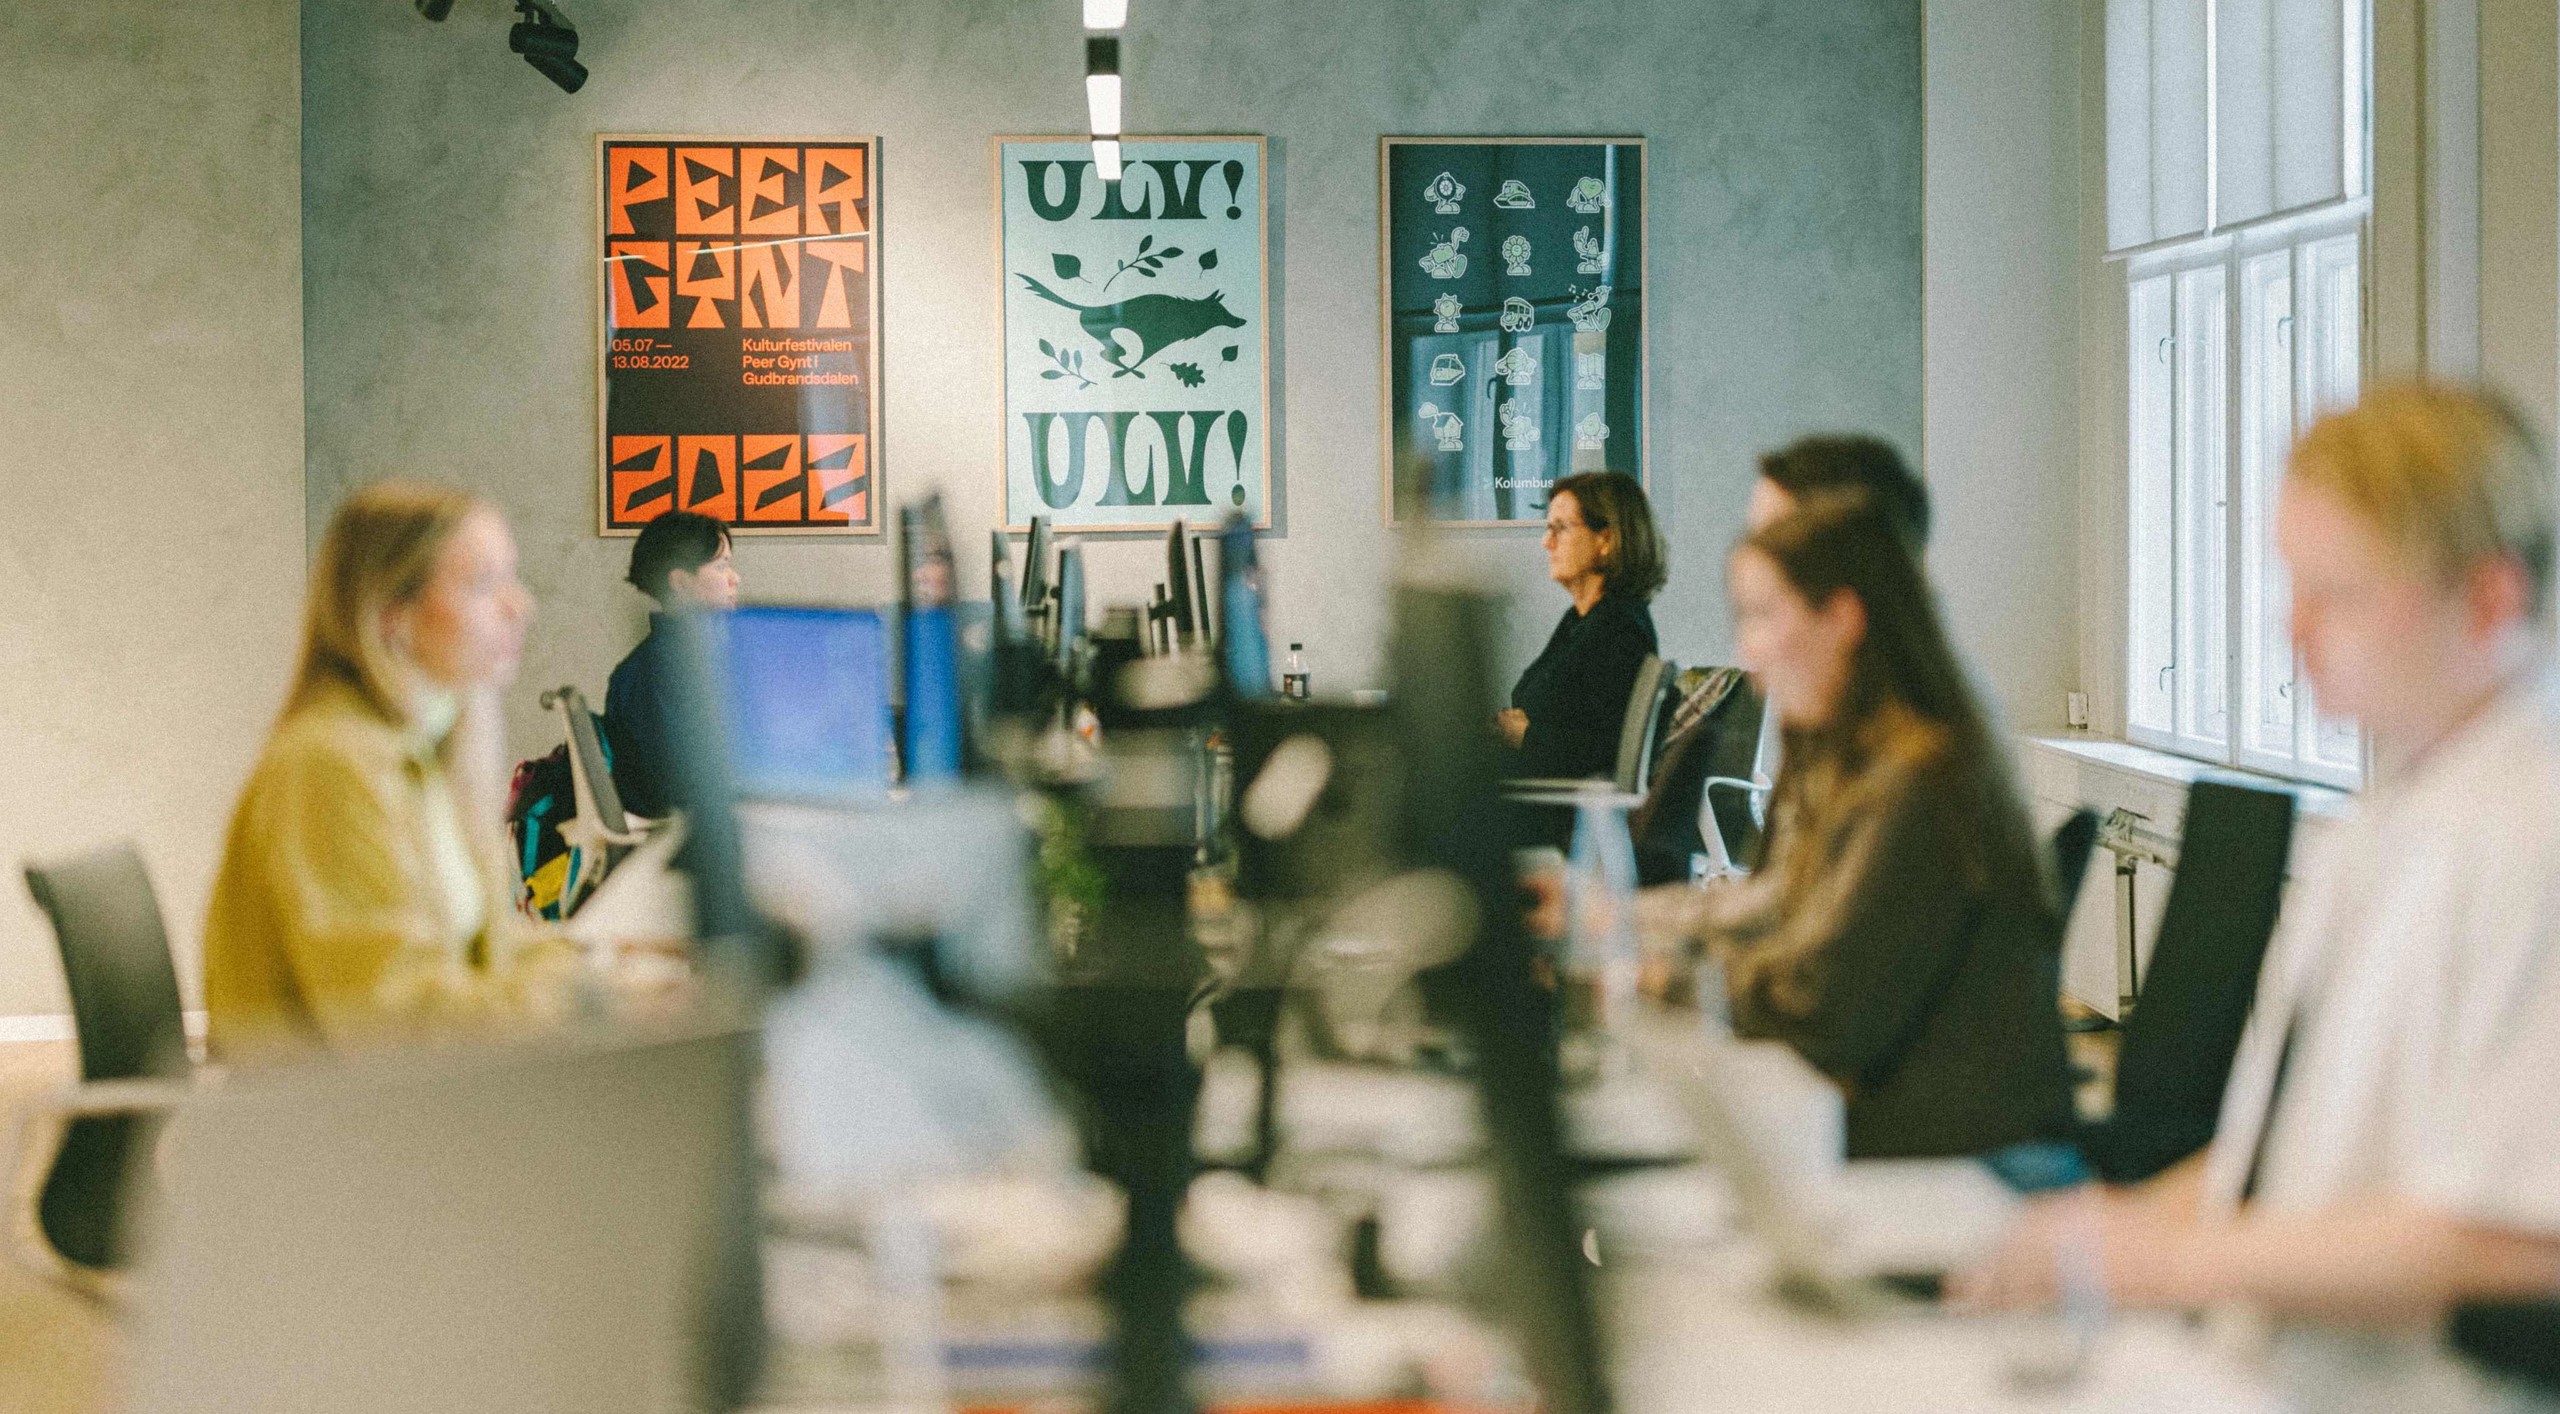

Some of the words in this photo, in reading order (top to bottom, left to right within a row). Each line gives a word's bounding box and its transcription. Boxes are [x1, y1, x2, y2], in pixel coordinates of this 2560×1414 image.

[609, 147, 865, 236] PEER
[1018, 159, 1244, 222] ULV!
[610, 241, 865, 329] GYNT
[612, 338, 654, 352] 05.07
[742, 338, 853, 352] Kulturfestivalen
[612, 355, 689, 369] 13.08.2022
[742, 355, 776, 369] Peer
[778, 355, 812, 371] Gynt
[814, 355, 819, 369] i
[742, 371, 859, 385] Gudbrandsdalen
[1022, 409, 1248, 511] ULV!
[612, 434, 867, 522] 2022
[1495, 476, 1554, 489] Kolumbus
